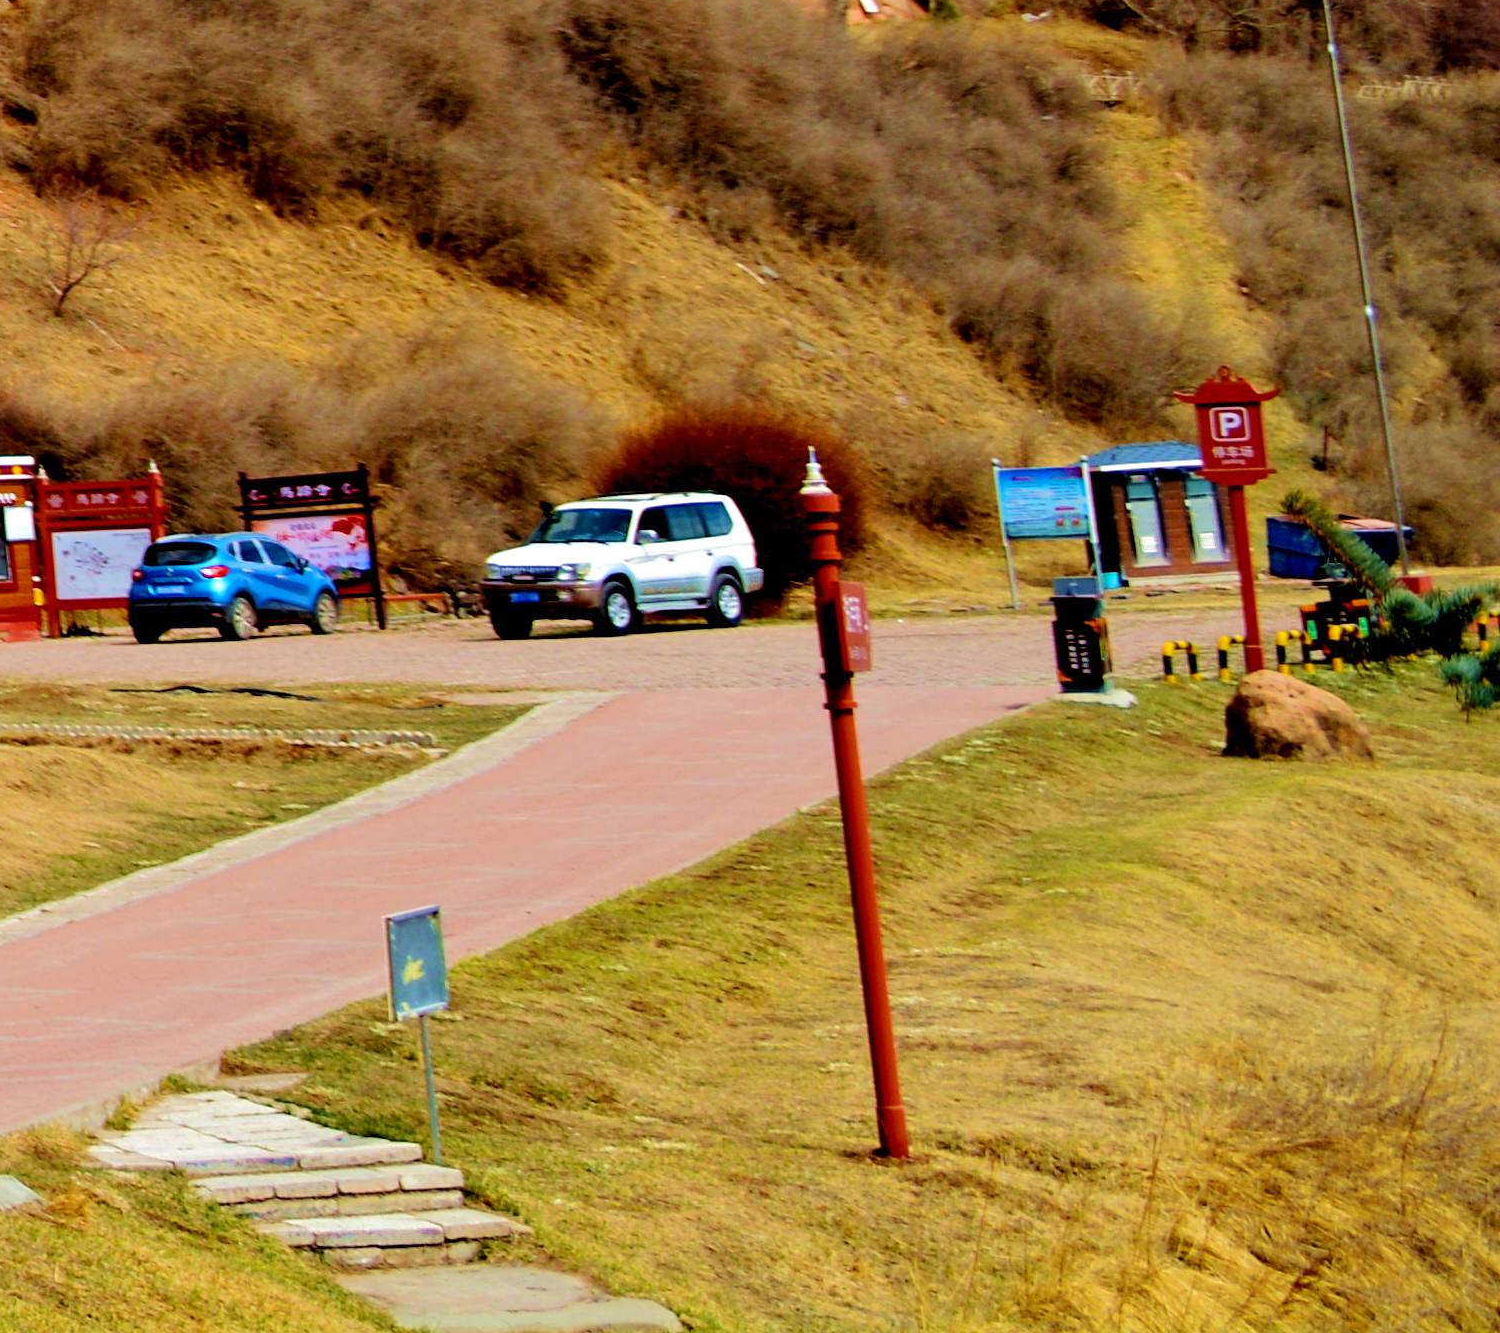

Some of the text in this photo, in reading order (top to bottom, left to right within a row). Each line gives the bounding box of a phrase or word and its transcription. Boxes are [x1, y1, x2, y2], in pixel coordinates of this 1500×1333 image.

[1218, 412, 1242, 437] P
[1212, 445, 1254, 458] 停车场
